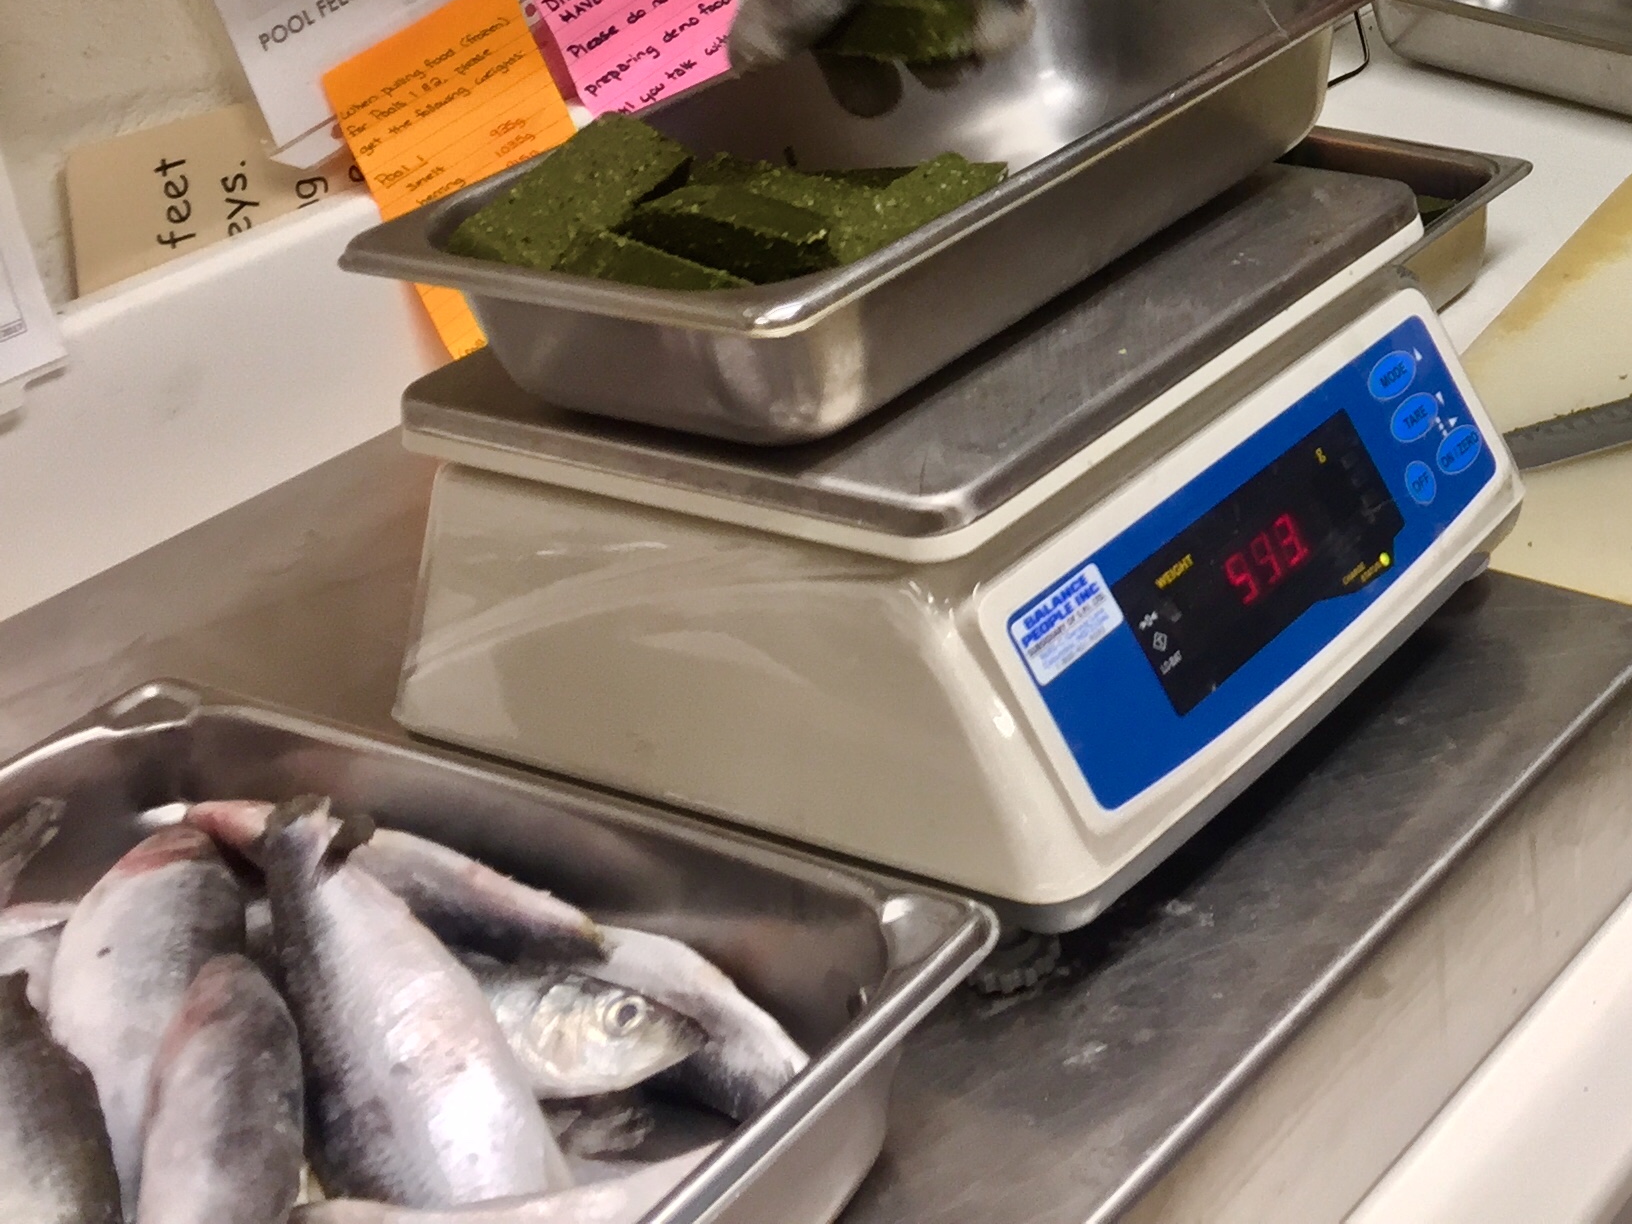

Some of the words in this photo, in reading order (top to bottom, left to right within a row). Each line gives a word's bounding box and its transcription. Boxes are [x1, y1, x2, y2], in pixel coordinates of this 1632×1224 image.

[257, 13, 311, 52] POOL
[565, 24, 621, 58] Please
[626, 8, 647, 25] do
[339, 95, 379, 121] When
[380, 64, 427, 99] pulling
[423, 47, 456, 71] food
[459, 15, 511, 48] (frozen)
[453, 47, 493, 76] please
[584, 44, 661, 97] preparing
[662, 16, 700, 44] demo
[639, 81, 666, 105] you
[666, 58, 698, 81] talk
[358, 137, 383, 157] get
[387, 118, 414, 138] the
[153, 156, 197, 250] feet
[1379, 362, 1408, 389] MODE
[1402, 404, 1430, 429] TARE
[1411, 470, 1431, 494] OFF
[1155, 553, 1195, 590] WEIGHT
[1021, 600, 1074, 649] PEOPLE
[1074, 582, 1101, 609] INC
[1023, 572, 1090, 631] BALANCE
